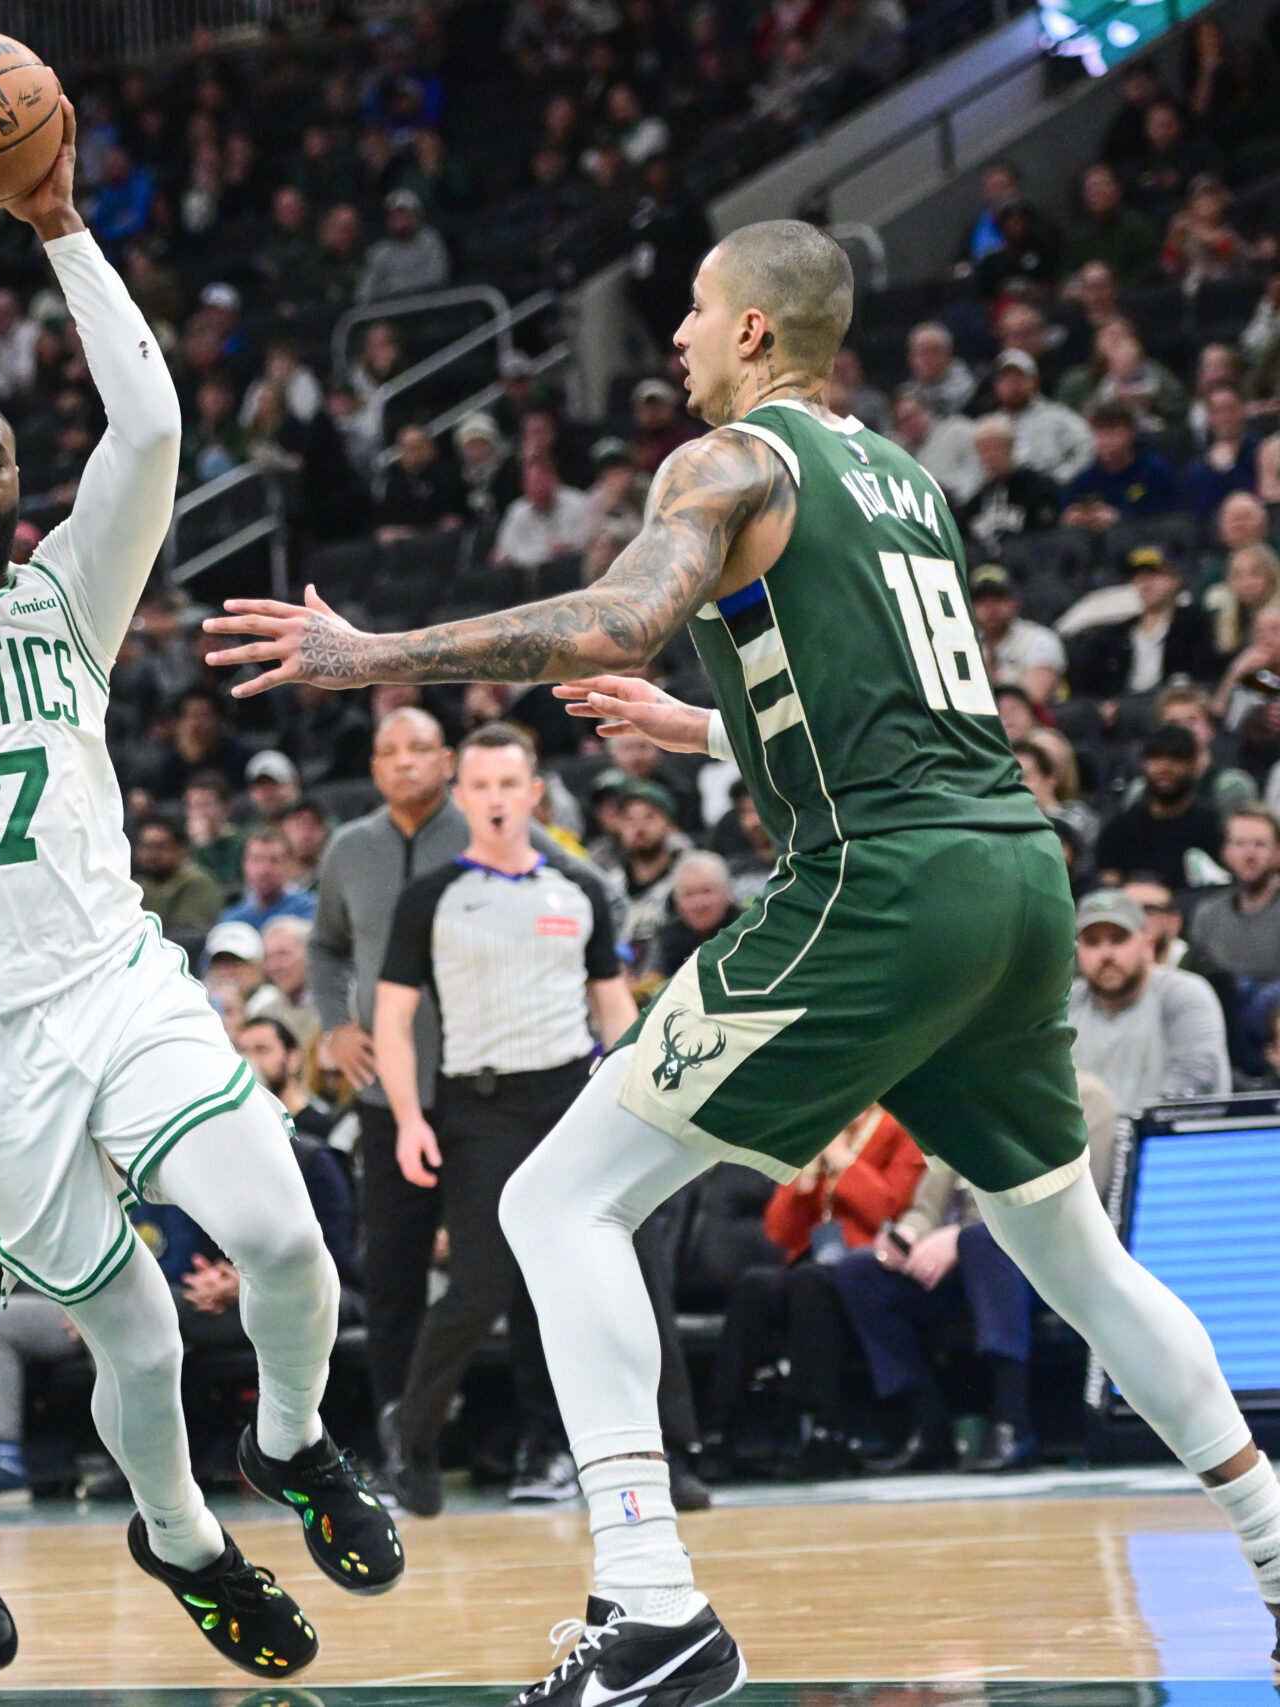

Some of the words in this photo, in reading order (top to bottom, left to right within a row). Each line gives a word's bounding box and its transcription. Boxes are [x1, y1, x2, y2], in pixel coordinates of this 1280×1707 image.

[840, 469, 941, 539] KUZMA
[10, 597, 58, 616] Amica
[878, 551, 999, 716] 18
